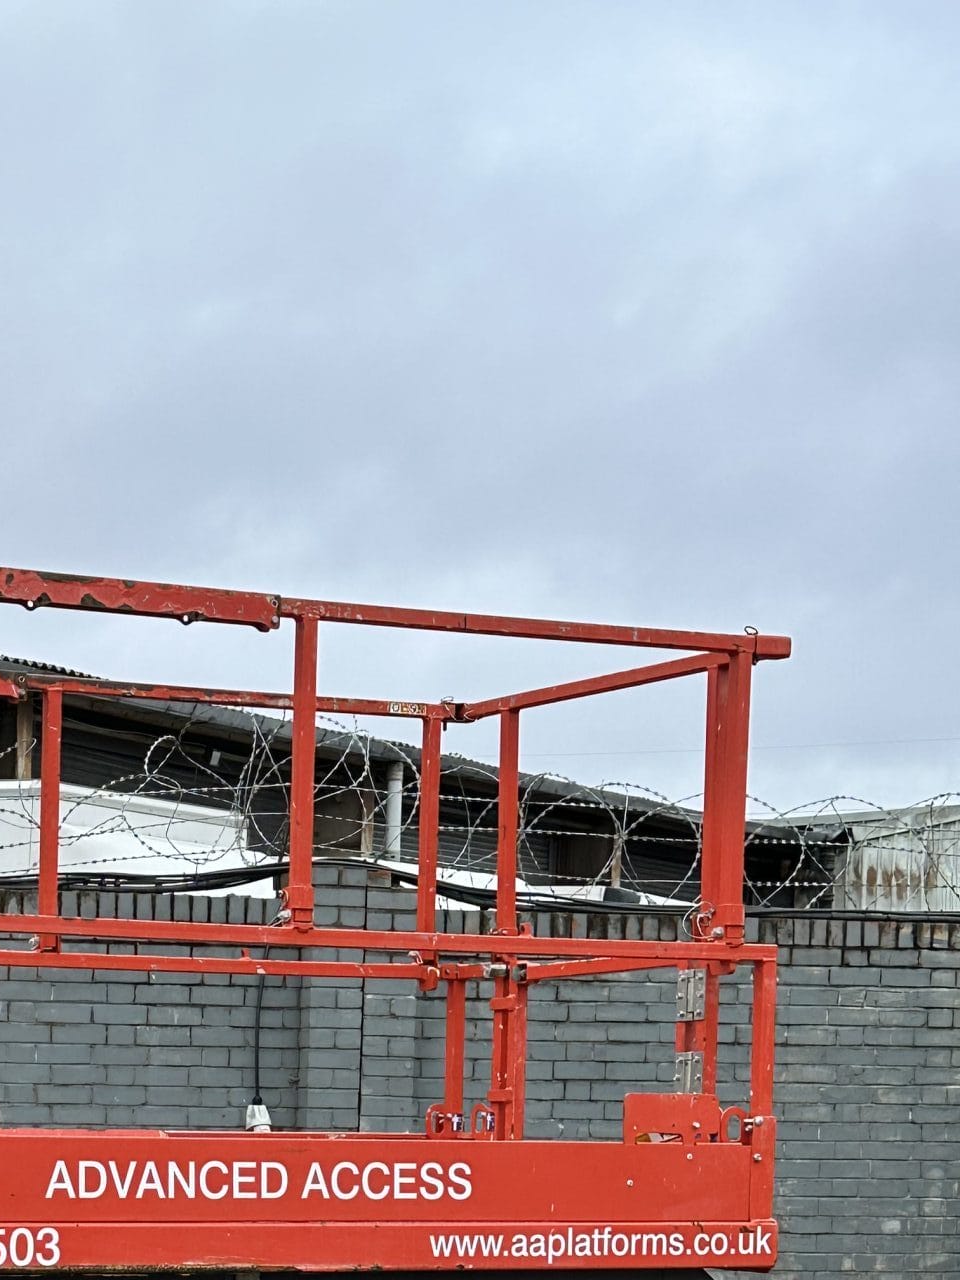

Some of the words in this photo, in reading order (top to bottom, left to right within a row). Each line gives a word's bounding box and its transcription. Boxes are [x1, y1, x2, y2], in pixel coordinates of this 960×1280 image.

[46, 1160, 289, 1200] ADVANCED
[301, 1161, 472, 1201] ACCESS
[429, 1226, 772, 1264] www.aaplatforms.co.uk
